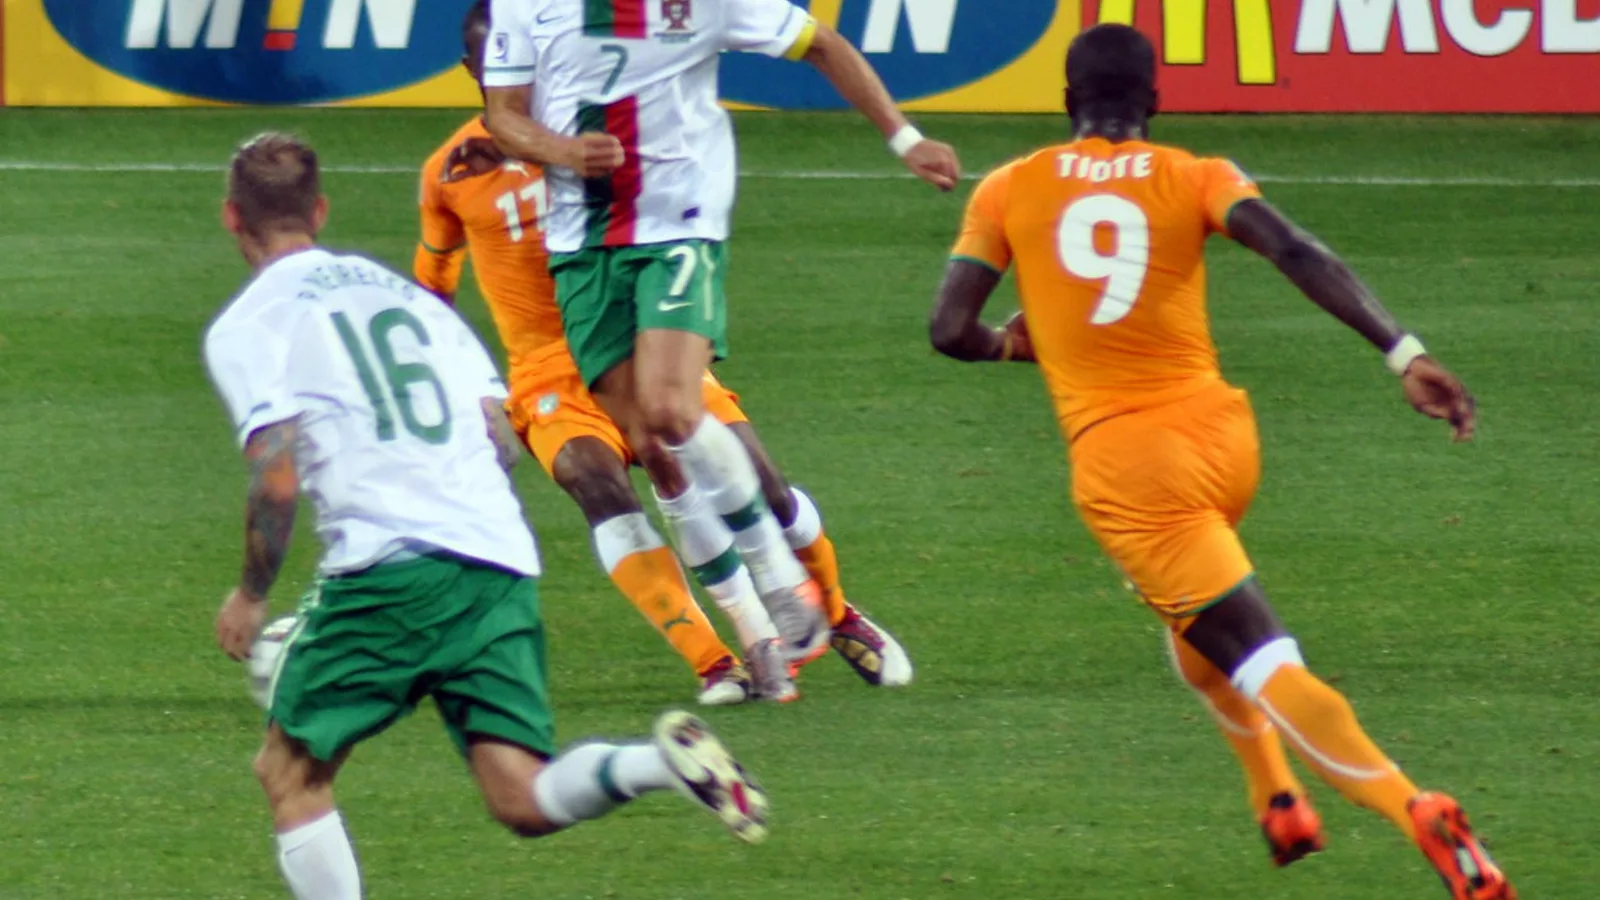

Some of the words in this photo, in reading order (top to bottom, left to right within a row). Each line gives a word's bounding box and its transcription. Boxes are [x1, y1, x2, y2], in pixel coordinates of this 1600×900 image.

[600, 44, 628, 96] 7
[1057, 153, 1153, 182] TIOTE
[496, 178, 547, 242] 17
[665, 245, 697, 297] 7
[1058, 194, 1149, 325] 9
[329, 307, 451, 445] 16
